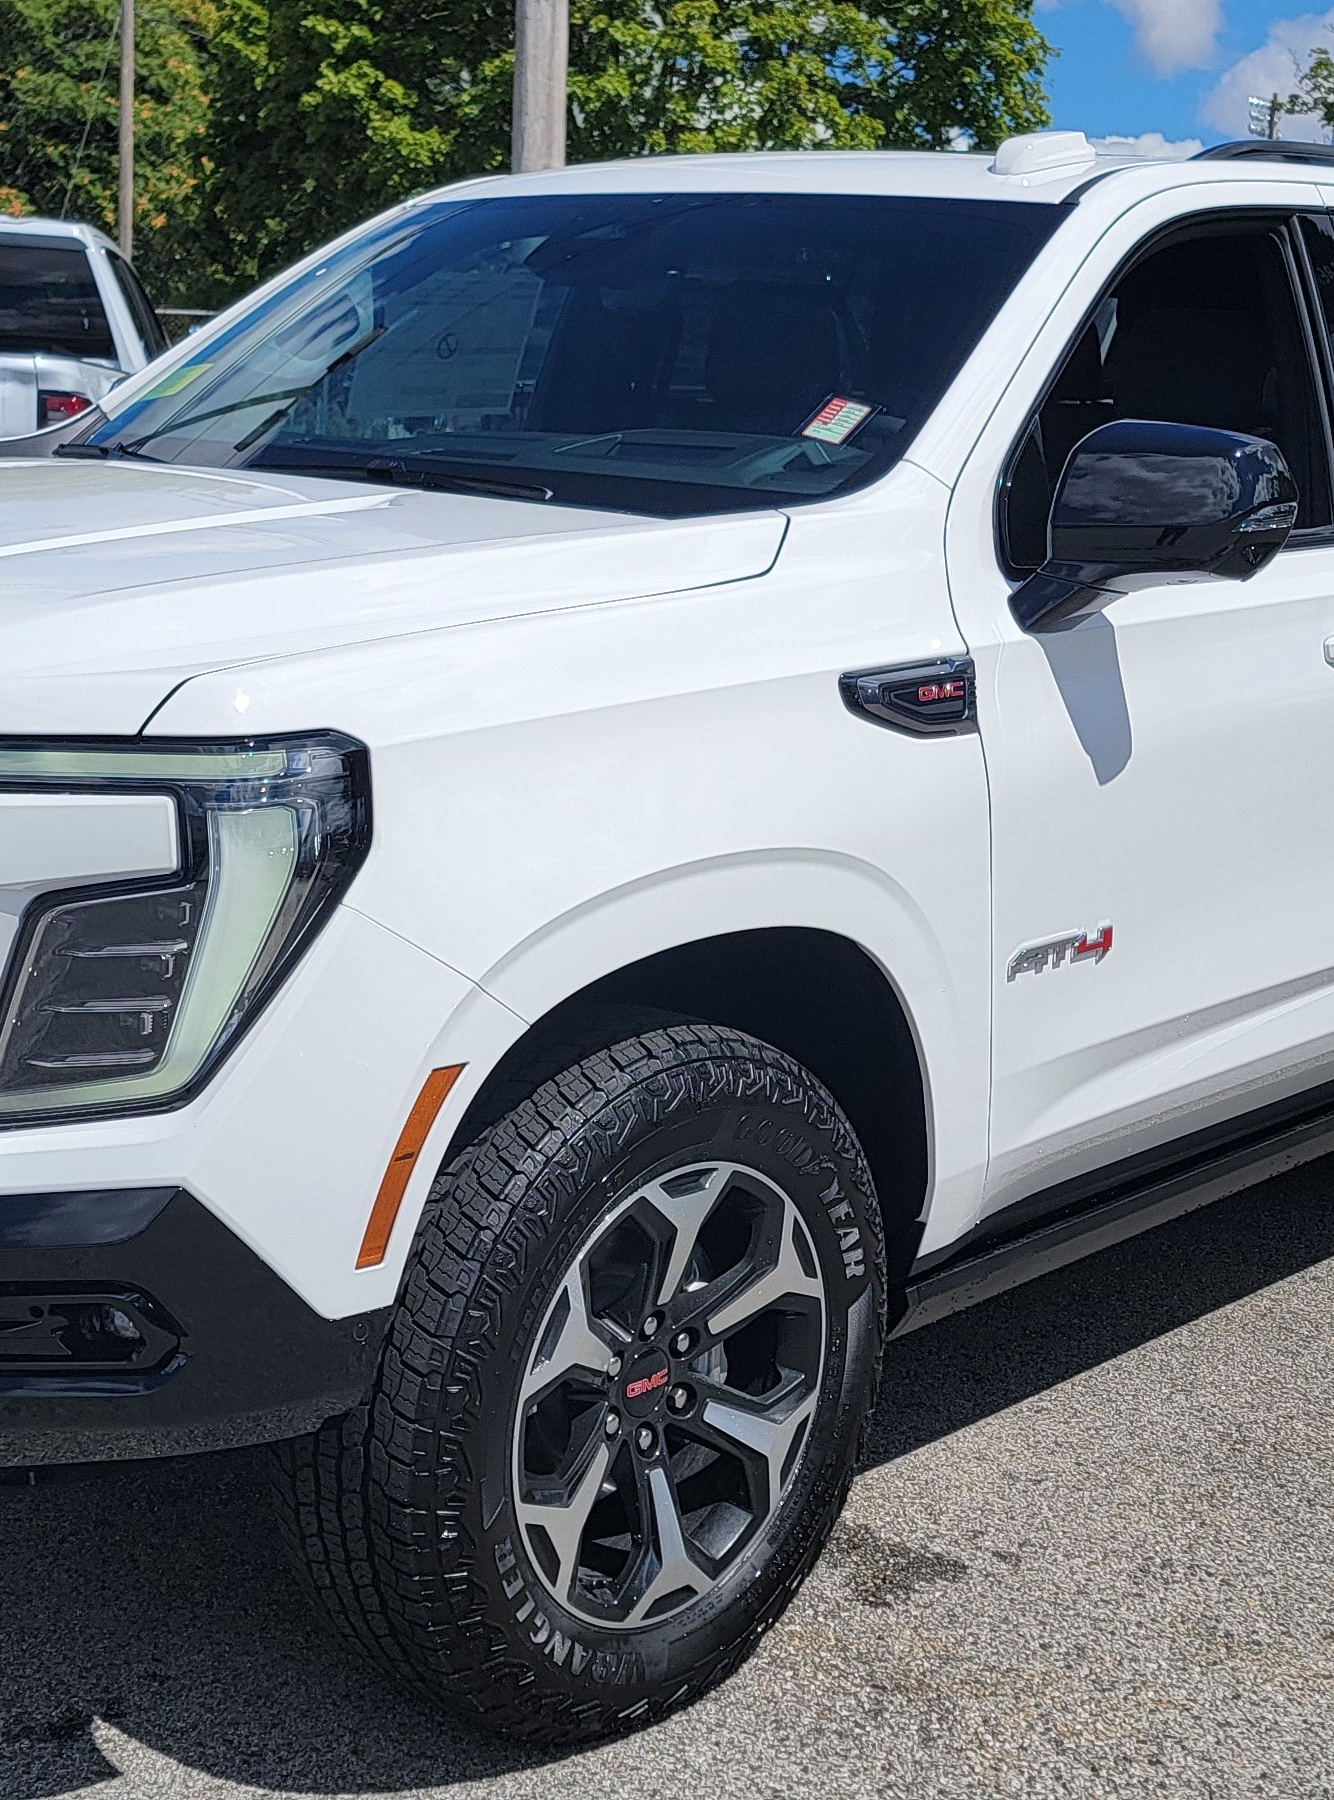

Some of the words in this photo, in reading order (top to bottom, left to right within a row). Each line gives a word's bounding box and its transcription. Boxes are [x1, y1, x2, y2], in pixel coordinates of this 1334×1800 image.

[918, 681, 964, 702] GMC
[1006, 921, 1113, 983] AT4
[626, 1368, 668, 1398] GMC
[494, 1536, 647, 1686] WRANGLER
